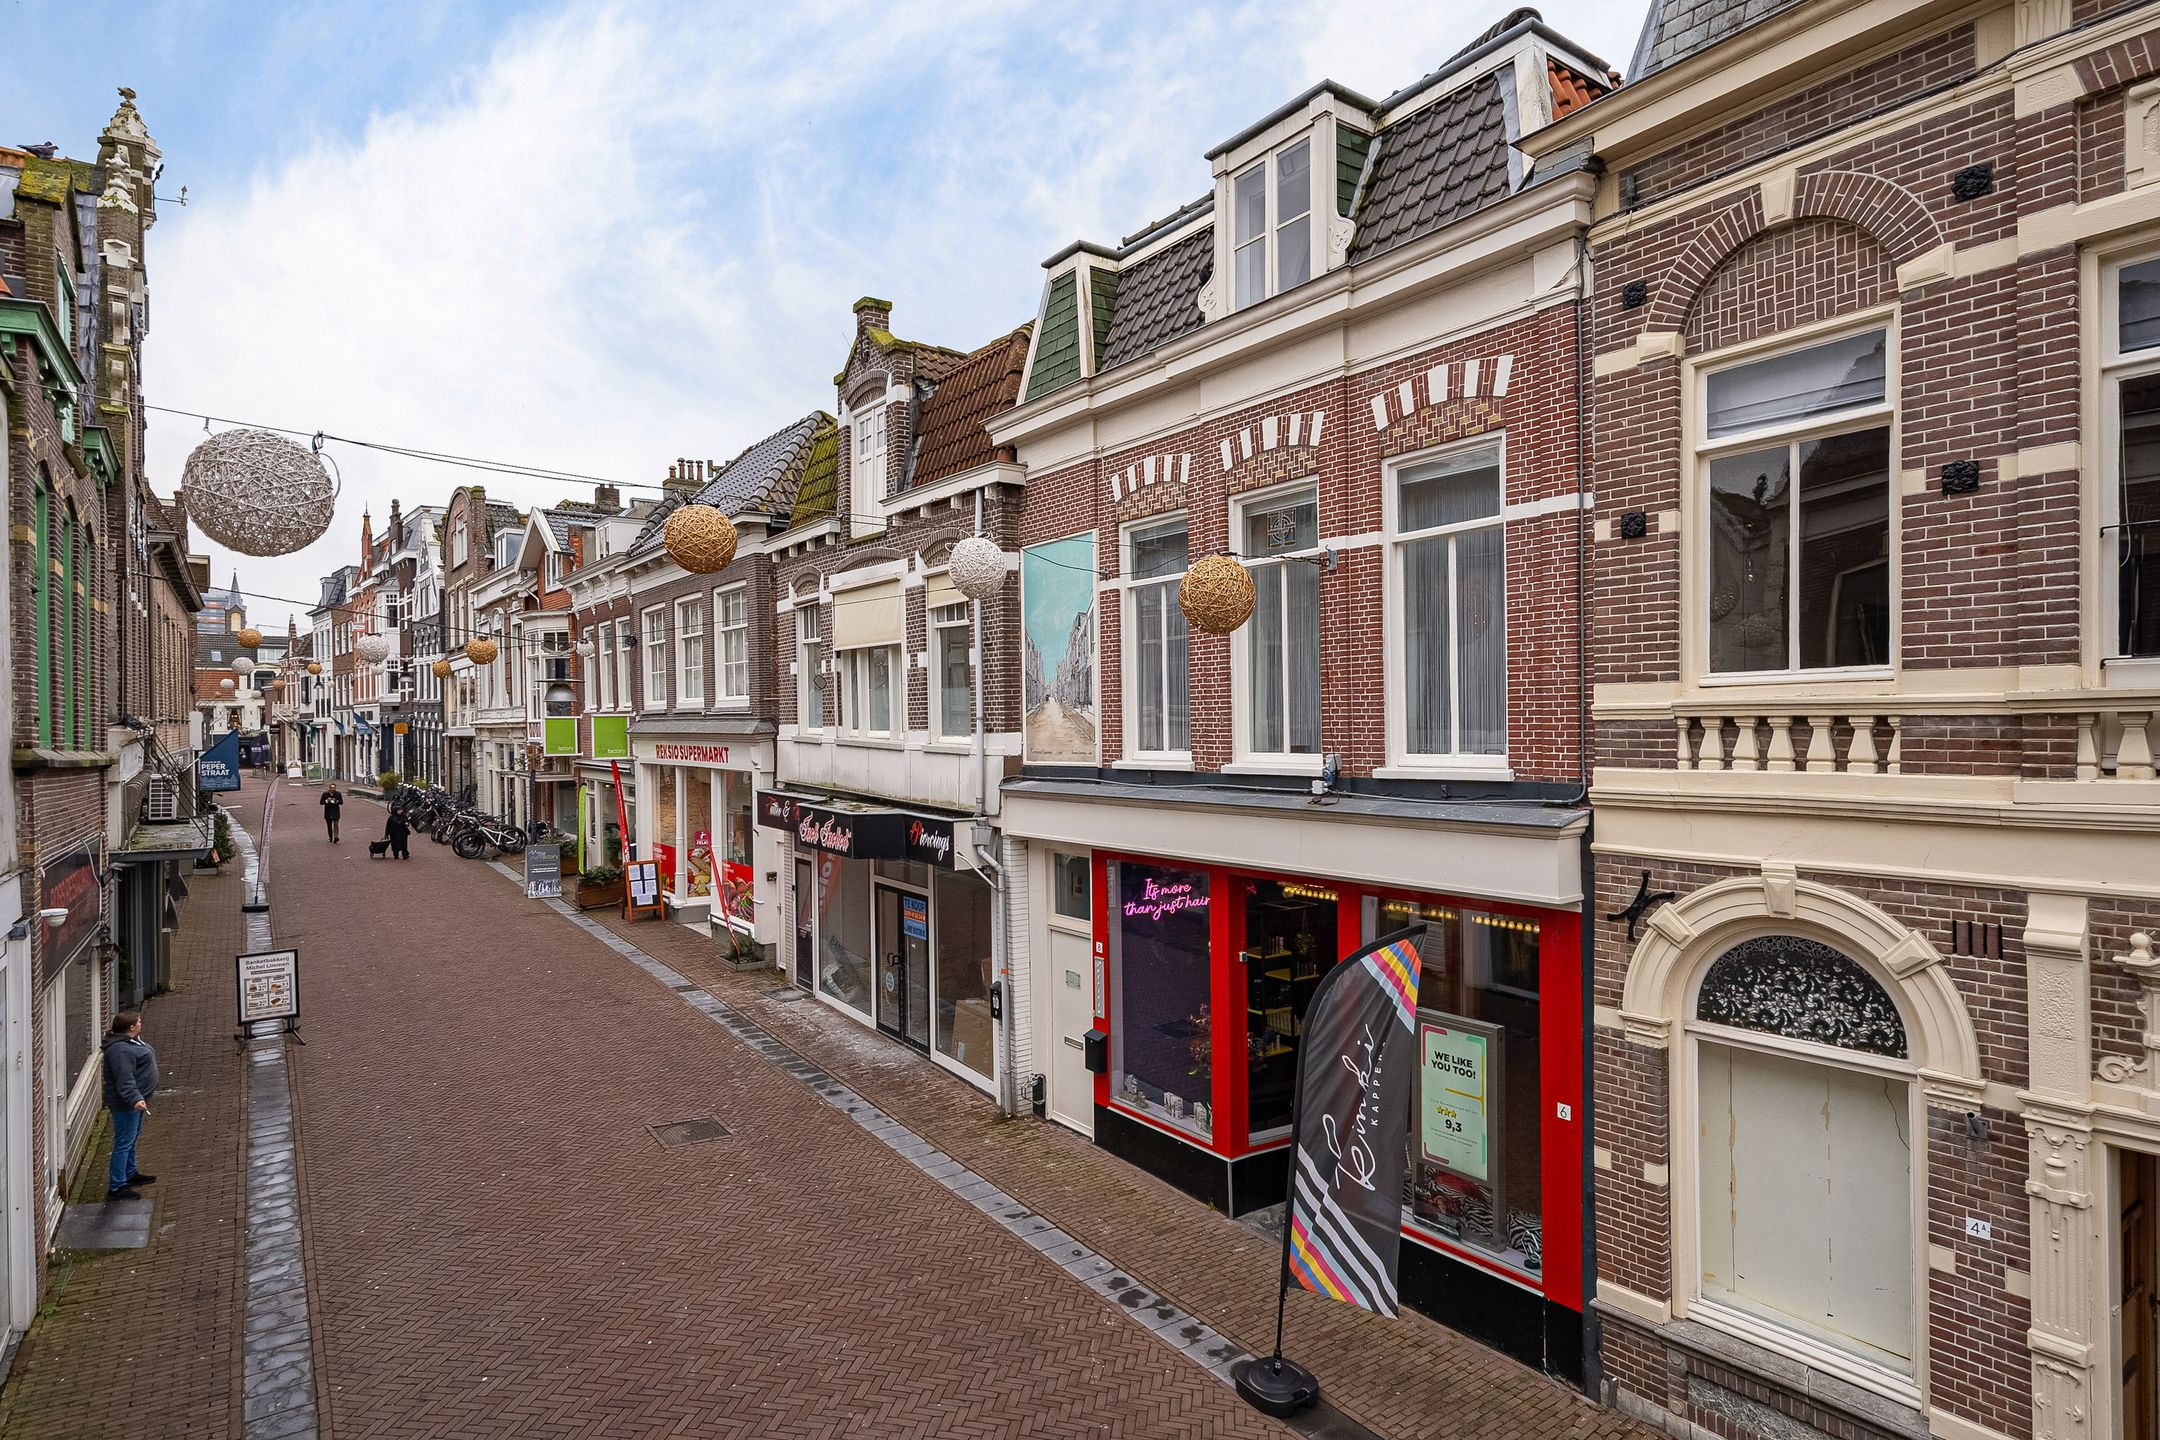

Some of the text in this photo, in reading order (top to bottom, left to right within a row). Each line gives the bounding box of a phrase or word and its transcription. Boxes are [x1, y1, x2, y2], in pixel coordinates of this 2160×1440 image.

[655, 744, 729, 763] REKSIO SUPERMARKT
[910, 819, 950, 861] Piercings
[1160, 884, 1192, 896] more
[1124, 895, 1211, 920] than just hair
[246, 956, 290, 966] Banketbakkerij
[246, 963, 266, 971] Michel
[1434, 1050, 1473, 1069] WE LIKE
[1431, 1059, 1476, 1080] YOU TOO!
[1560, 1106, 1567, 1118] 6
[1445, 1118, 1462, 1134] 9,3
